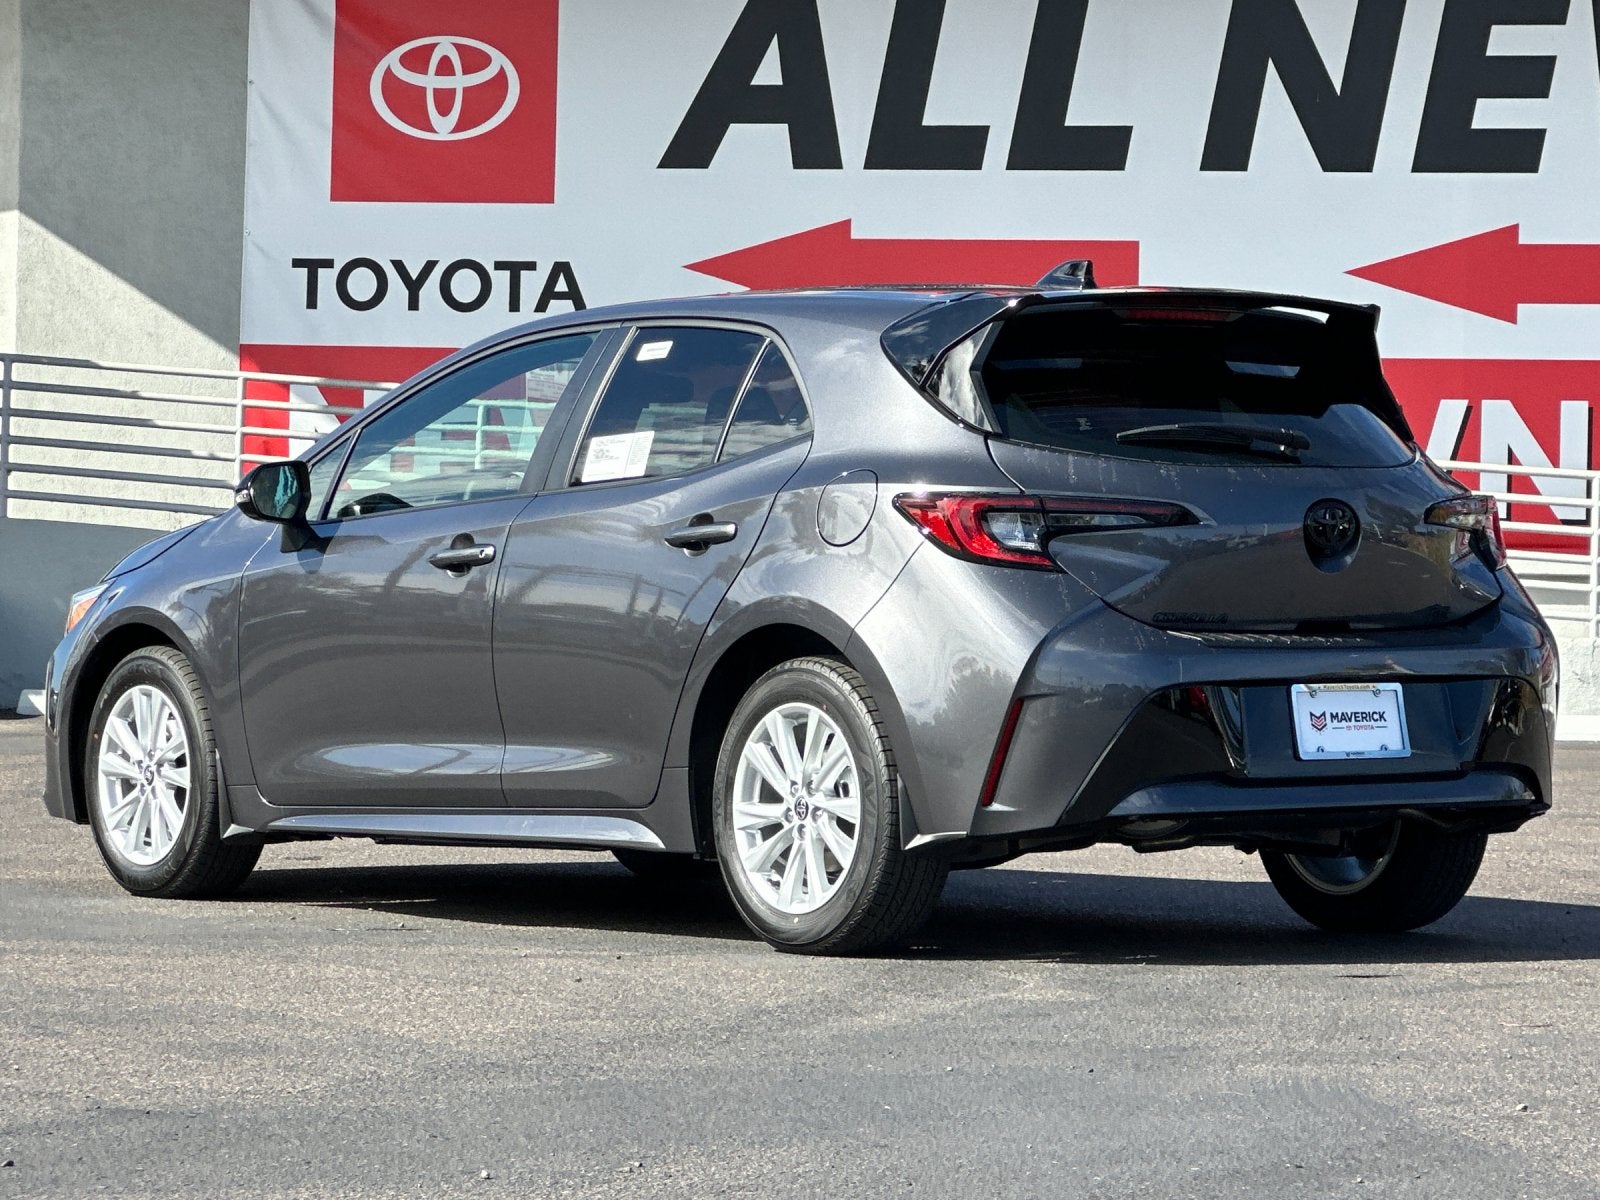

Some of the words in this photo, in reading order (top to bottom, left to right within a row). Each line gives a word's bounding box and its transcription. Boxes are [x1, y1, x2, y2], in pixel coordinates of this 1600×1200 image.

[657, 0, 1133, 170] ALL
[1199, 0, 1600, 173] NE
[291, 256, 587, 314] TOYOTA
[1330, 711, 1387, 723] MAVERICK
